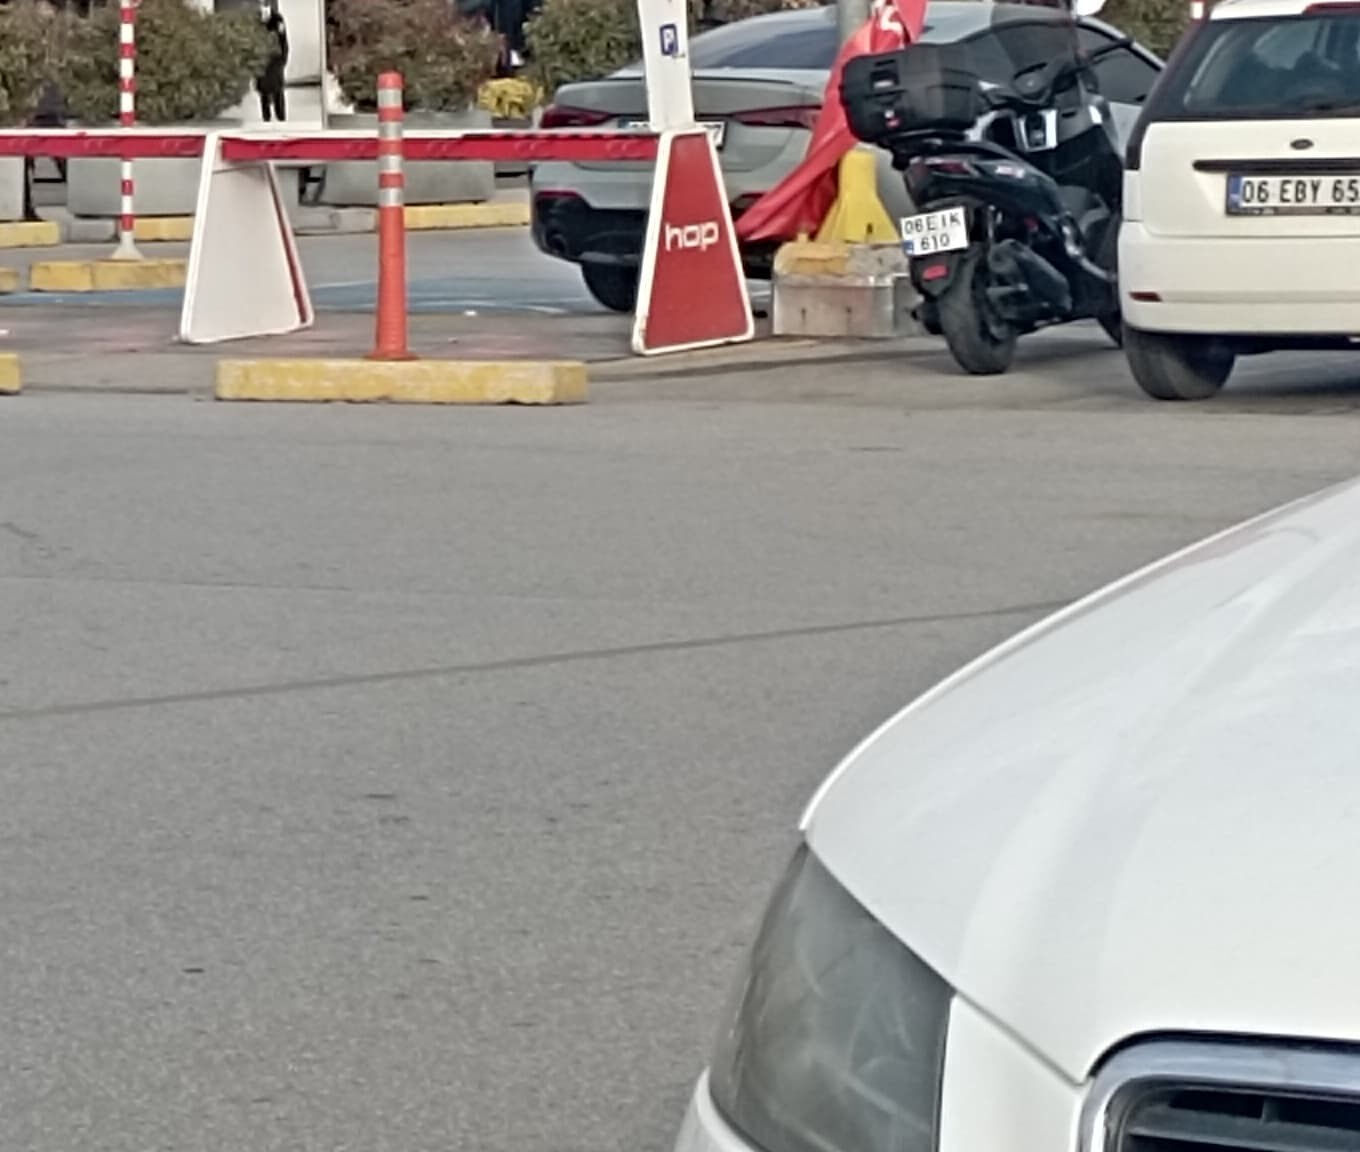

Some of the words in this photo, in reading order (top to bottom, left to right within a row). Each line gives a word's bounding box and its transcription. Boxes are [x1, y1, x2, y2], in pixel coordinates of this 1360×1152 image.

[1243, 180, 1269, 203] 06
[1281, 179, 1321, 203] EBY
[665, 221, 719, 252] hop
[921, 233, 951, 250] 610
